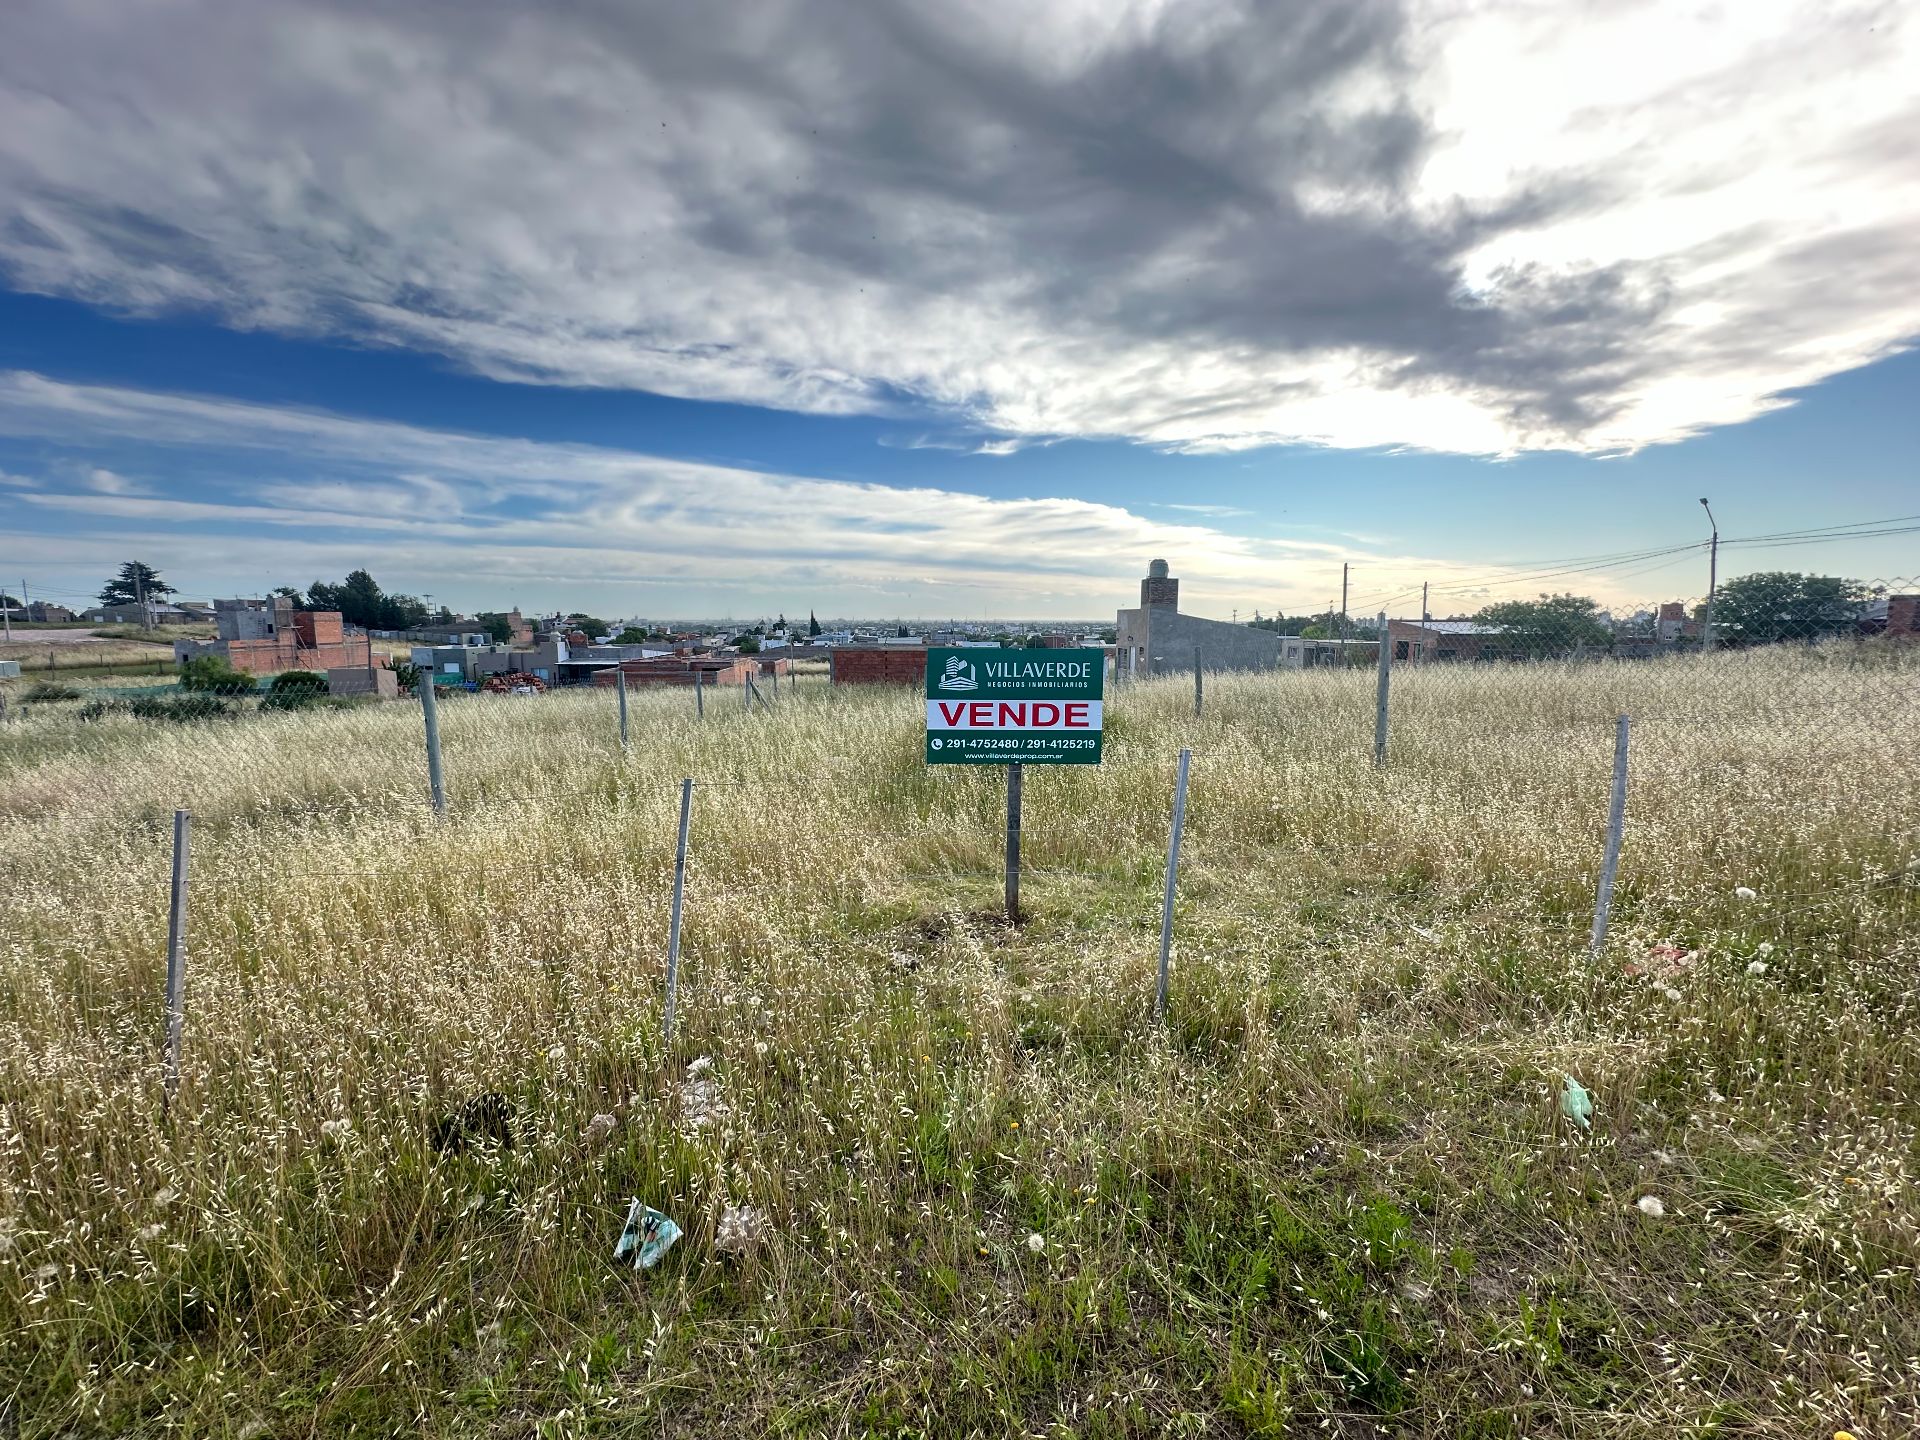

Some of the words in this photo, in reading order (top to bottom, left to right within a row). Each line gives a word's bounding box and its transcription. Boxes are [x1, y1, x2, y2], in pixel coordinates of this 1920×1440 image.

[985, 662, 1091, 678] VILLAVERDE
[938, 703, 1089, 727] VENDE
[946, 739, 1019, 749] 291-4752480
[1020, 739, 1025, 749] /
[1027, 739, 1096, 749] 291-4125219
